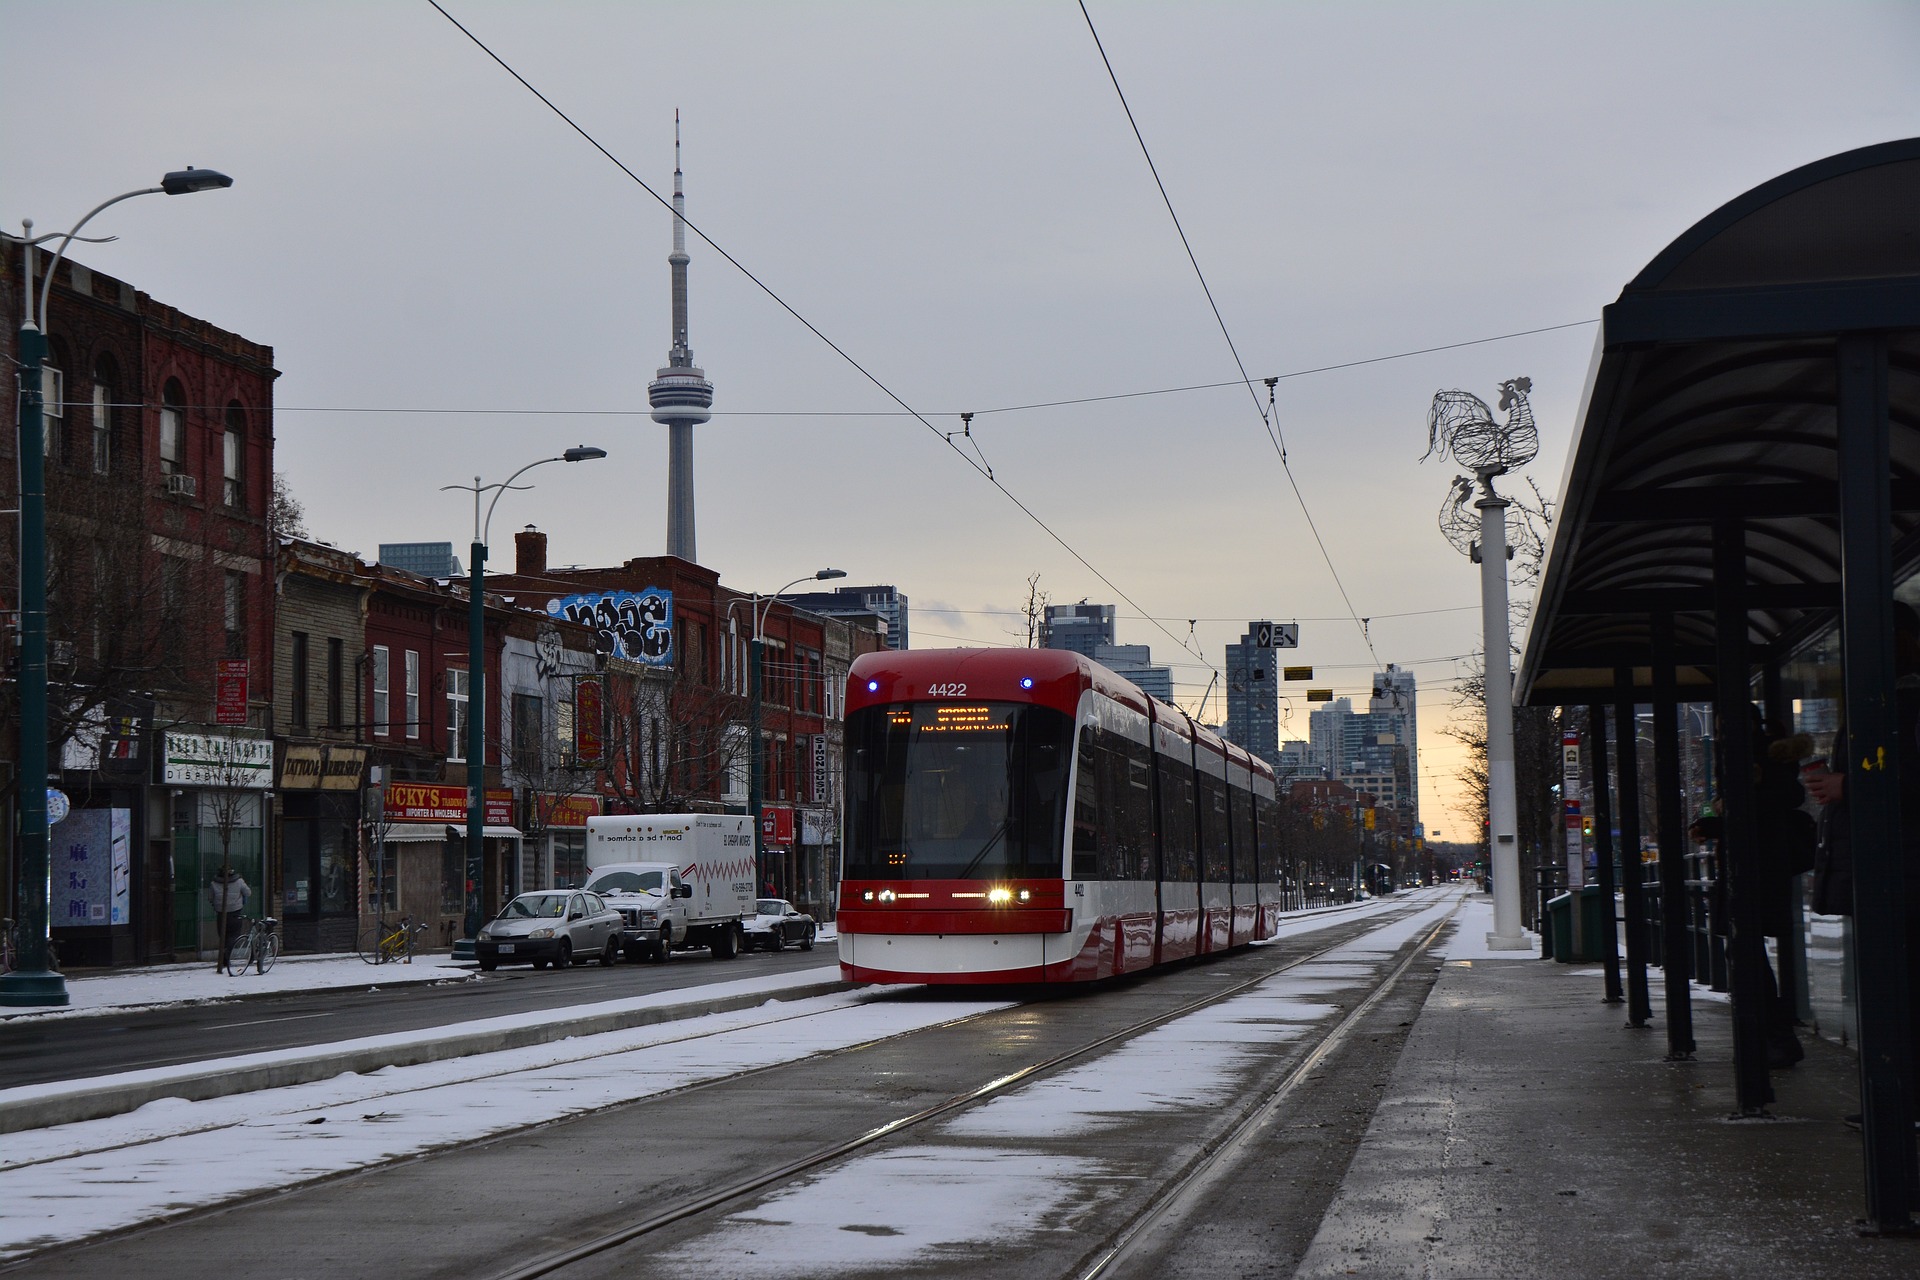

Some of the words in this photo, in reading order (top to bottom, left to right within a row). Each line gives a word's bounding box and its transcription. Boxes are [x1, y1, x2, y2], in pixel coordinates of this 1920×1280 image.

[928, 683, 967, 697] 4422
[206, 739, 228, 756] THE
[815, 737, 825, 767] SIMON
[286, 758, 315, 776] TATTOO
[815, 768, 825, 800] SUSHI
[385, 786, 440, 808] UCKY'S
[405, 808, 430, 817] IMPORTER
[429, 809, 434, 818] &
[434, 809, 462, 819] WHOLESALE
